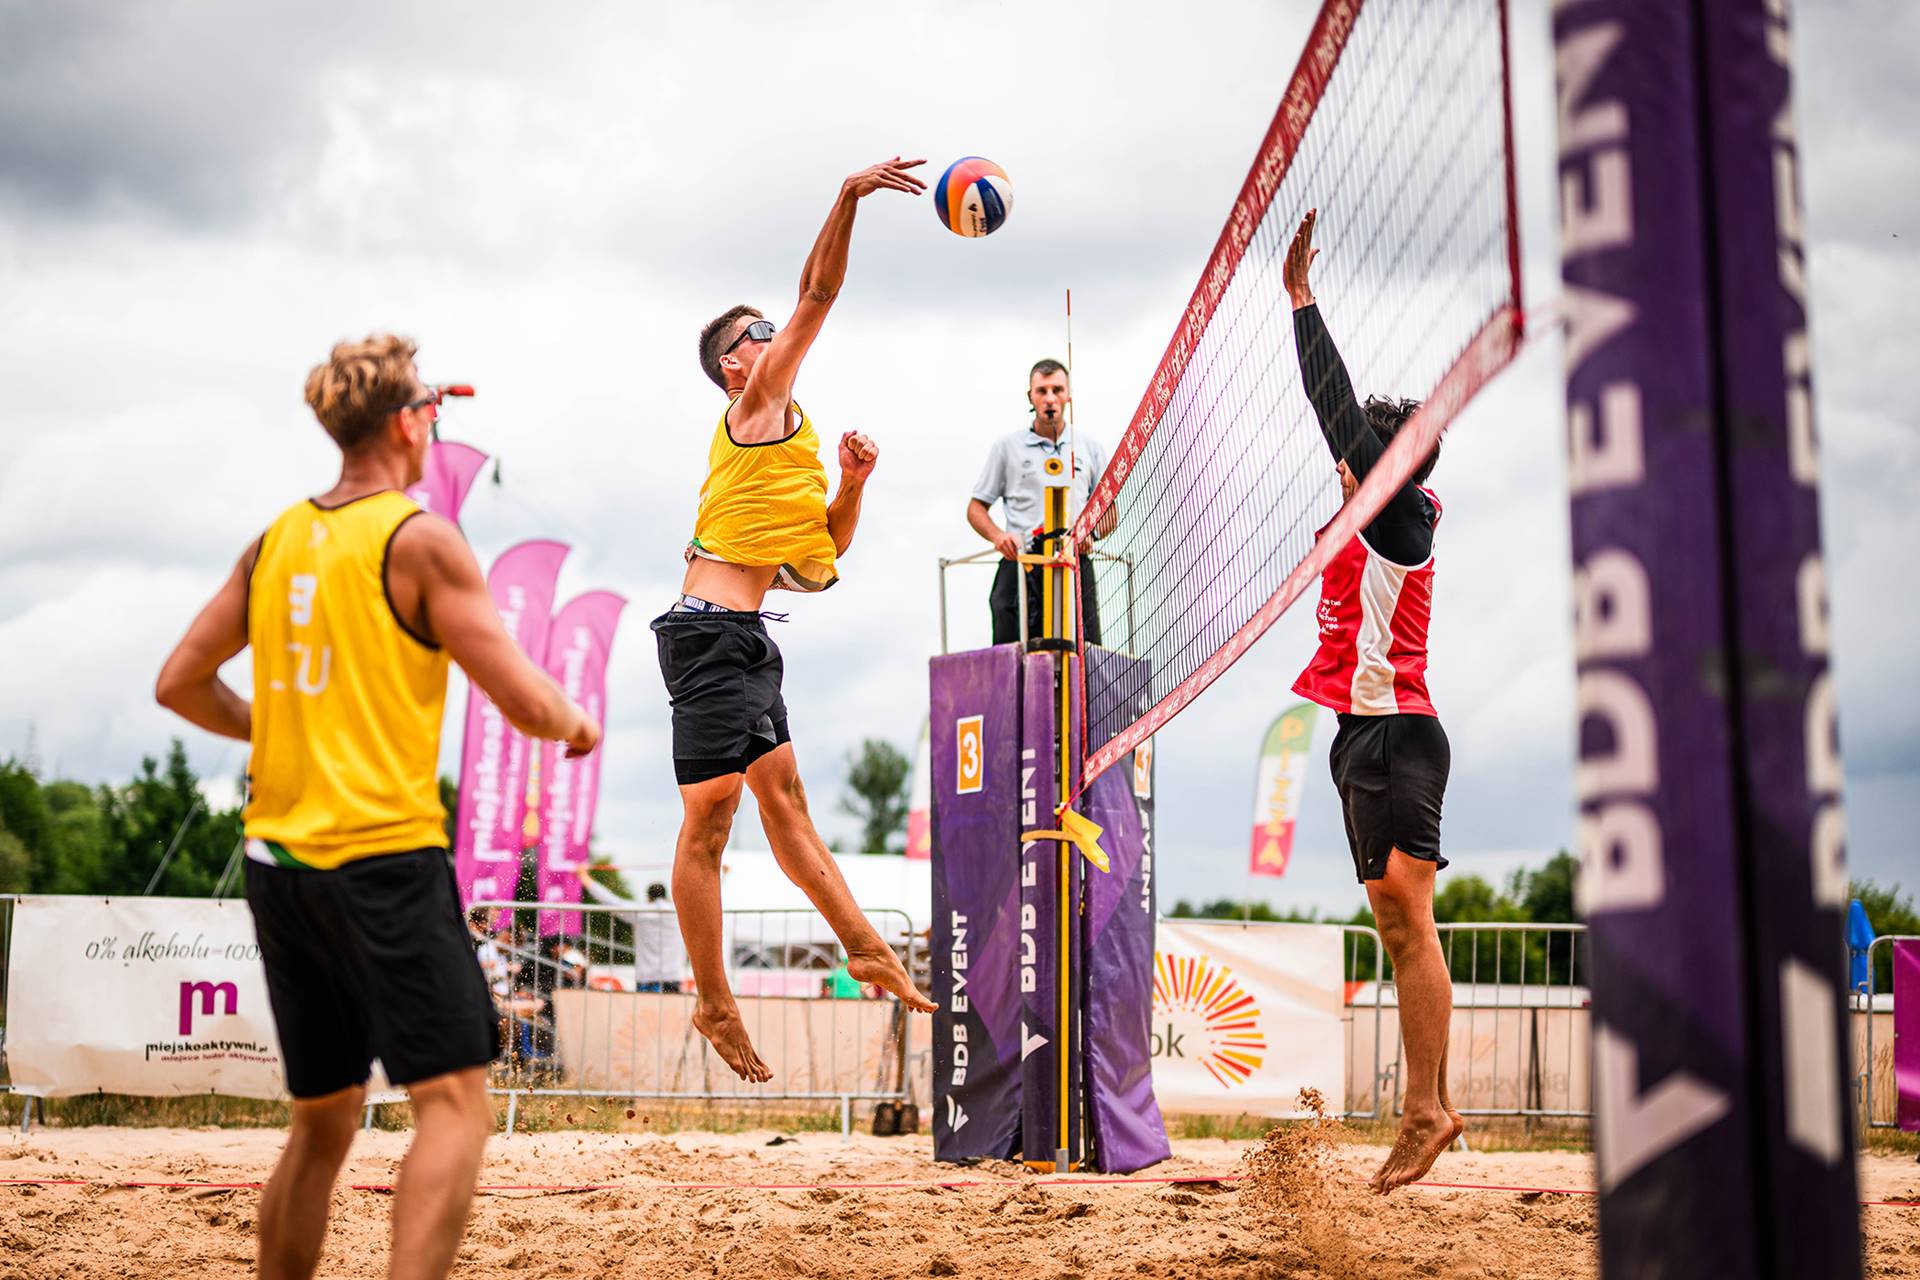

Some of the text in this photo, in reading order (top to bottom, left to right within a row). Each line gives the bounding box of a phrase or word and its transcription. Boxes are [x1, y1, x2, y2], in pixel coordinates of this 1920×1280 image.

[1554, 0, 1646, 496] EVEN
[962, 731, 979, 779] 3
[85, 936, 117, 960] 0%
[951, 910, 969, 1086] BDB EVENT
